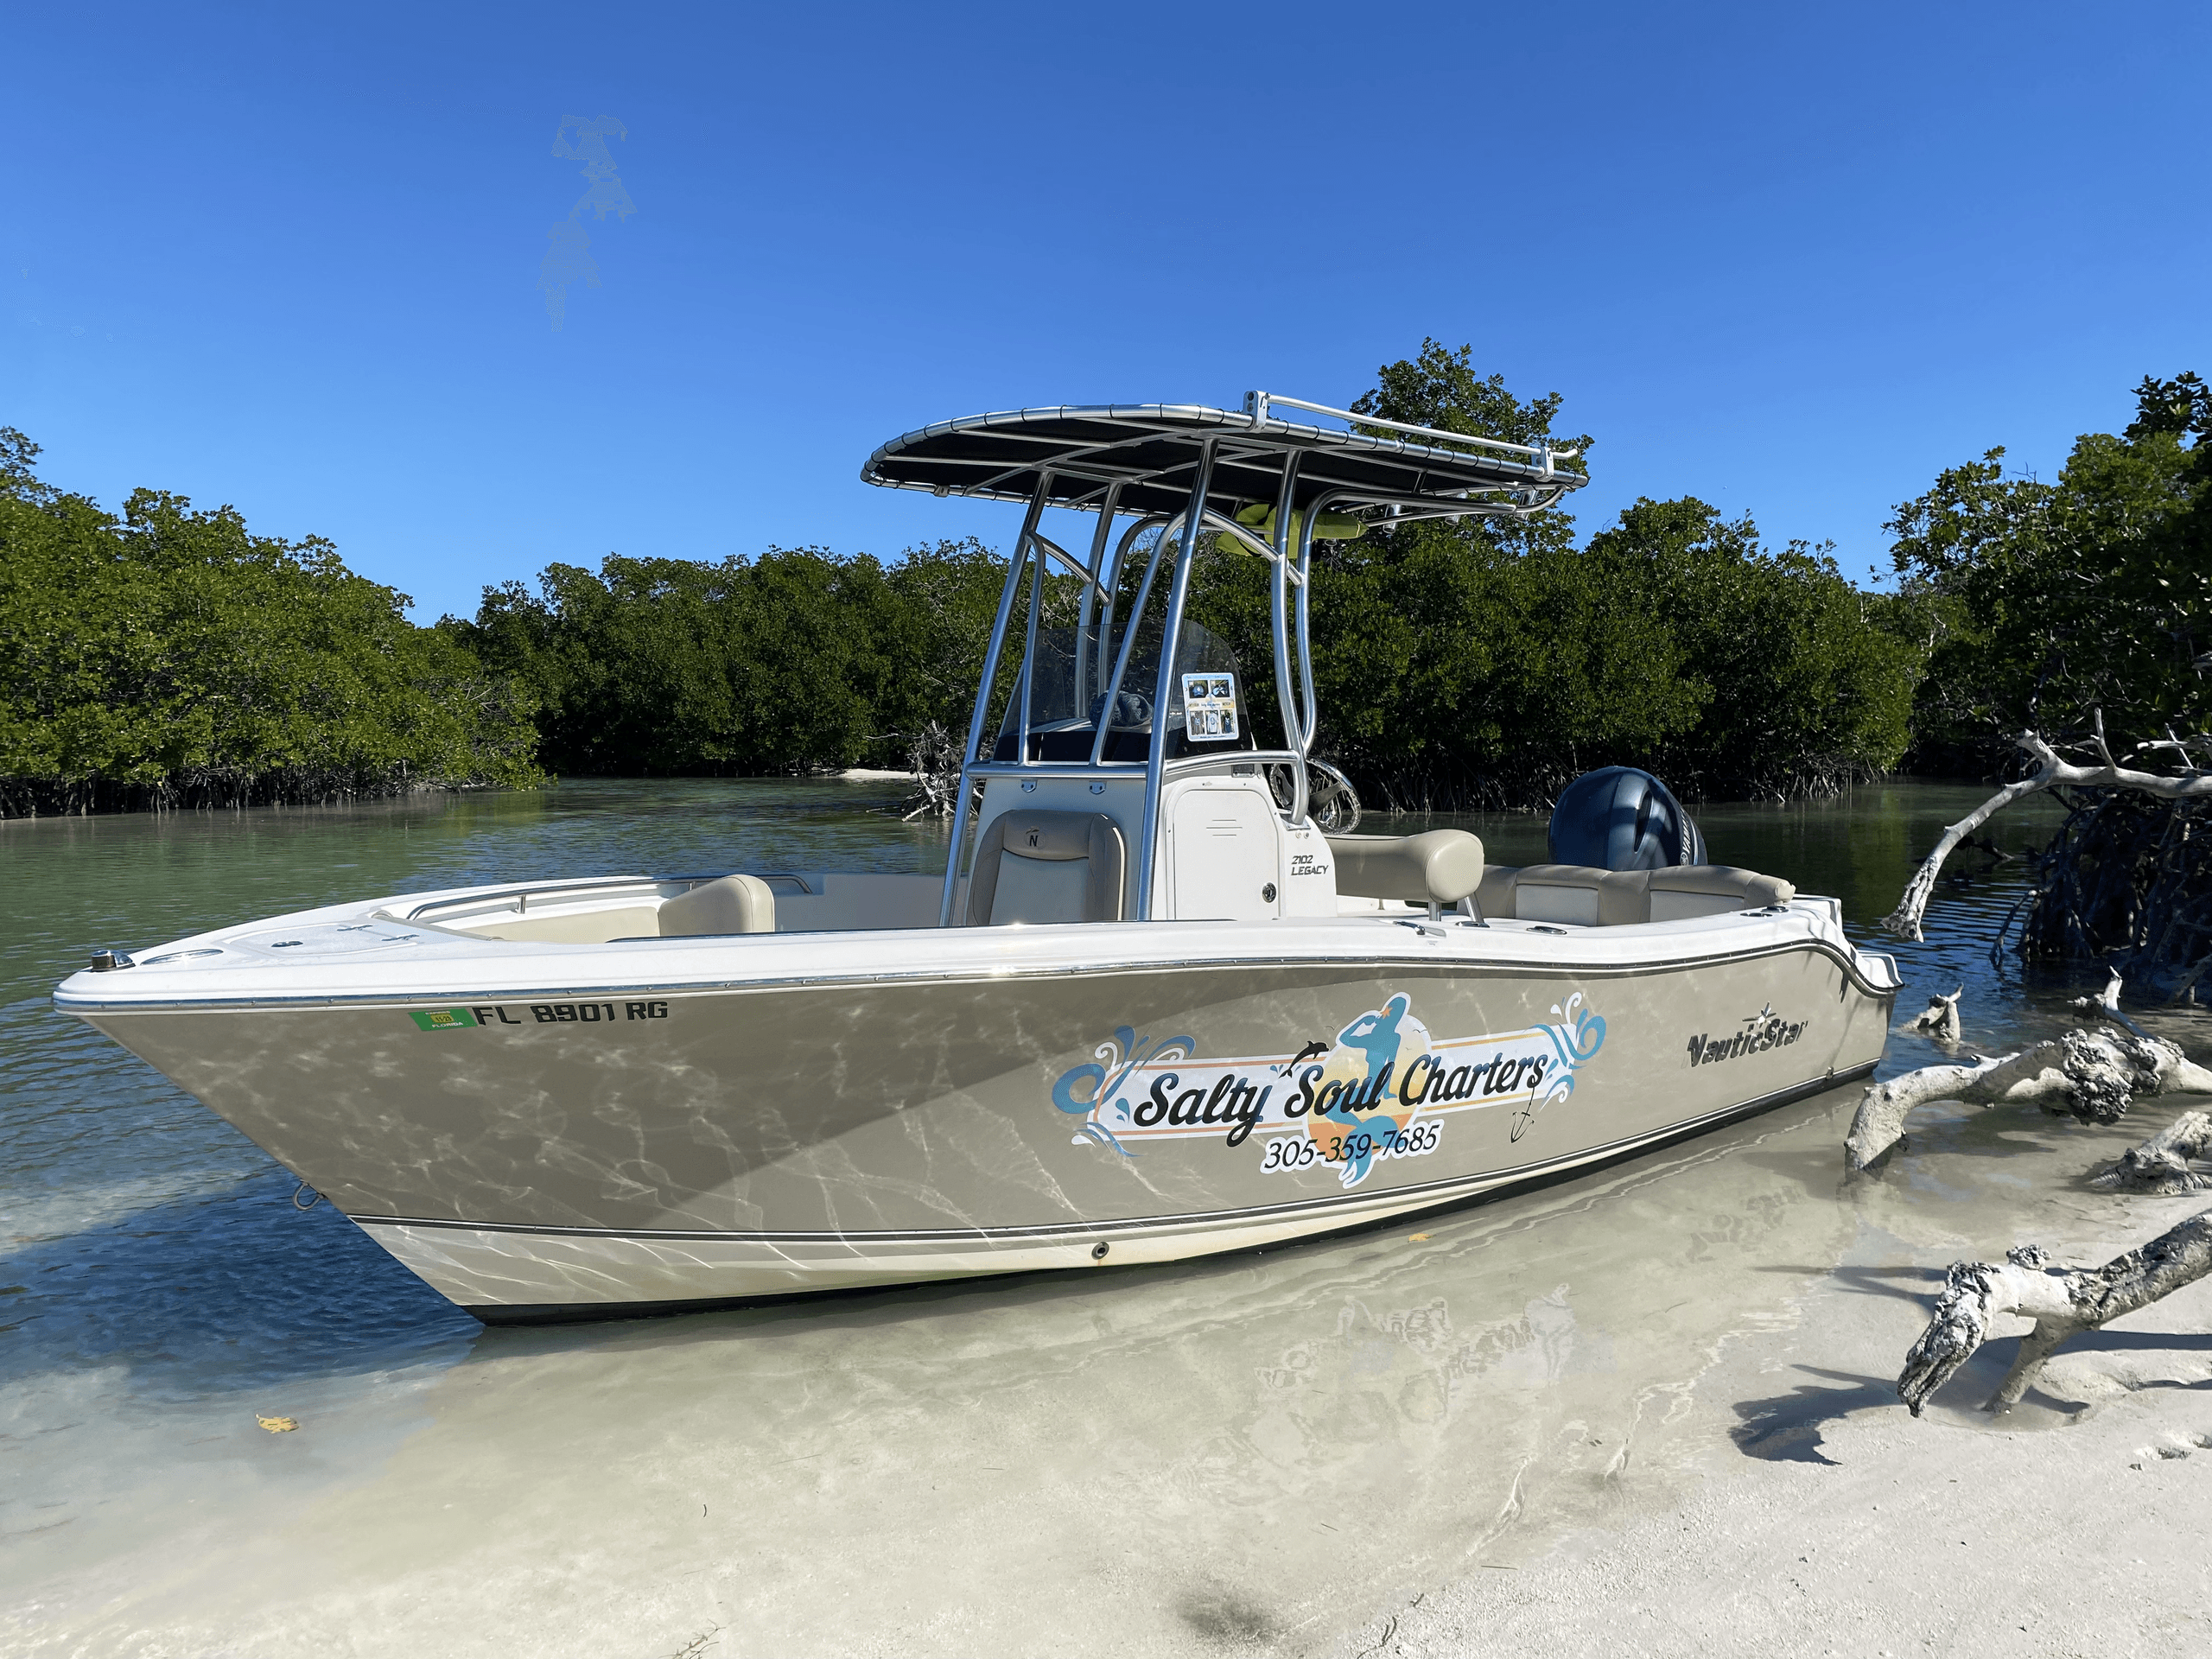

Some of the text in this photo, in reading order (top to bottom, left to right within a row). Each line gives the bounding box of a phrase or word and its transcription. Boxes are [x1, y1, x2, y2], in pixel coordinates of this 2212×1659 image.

[1029, 835, 1039, 847] N
[1291, 855, 1313, 865] 2102
[1291, 865, 1329, 876] LEGACY
[472, 1001, 668, 1026] FL 8901 RG
[1687, 1018, 1808, 1068] NauticStar
[1133, 1052, 1548, 1147] Salty Soul Charters
[1264, 1124, 1440, 1169] 305-359-7685
